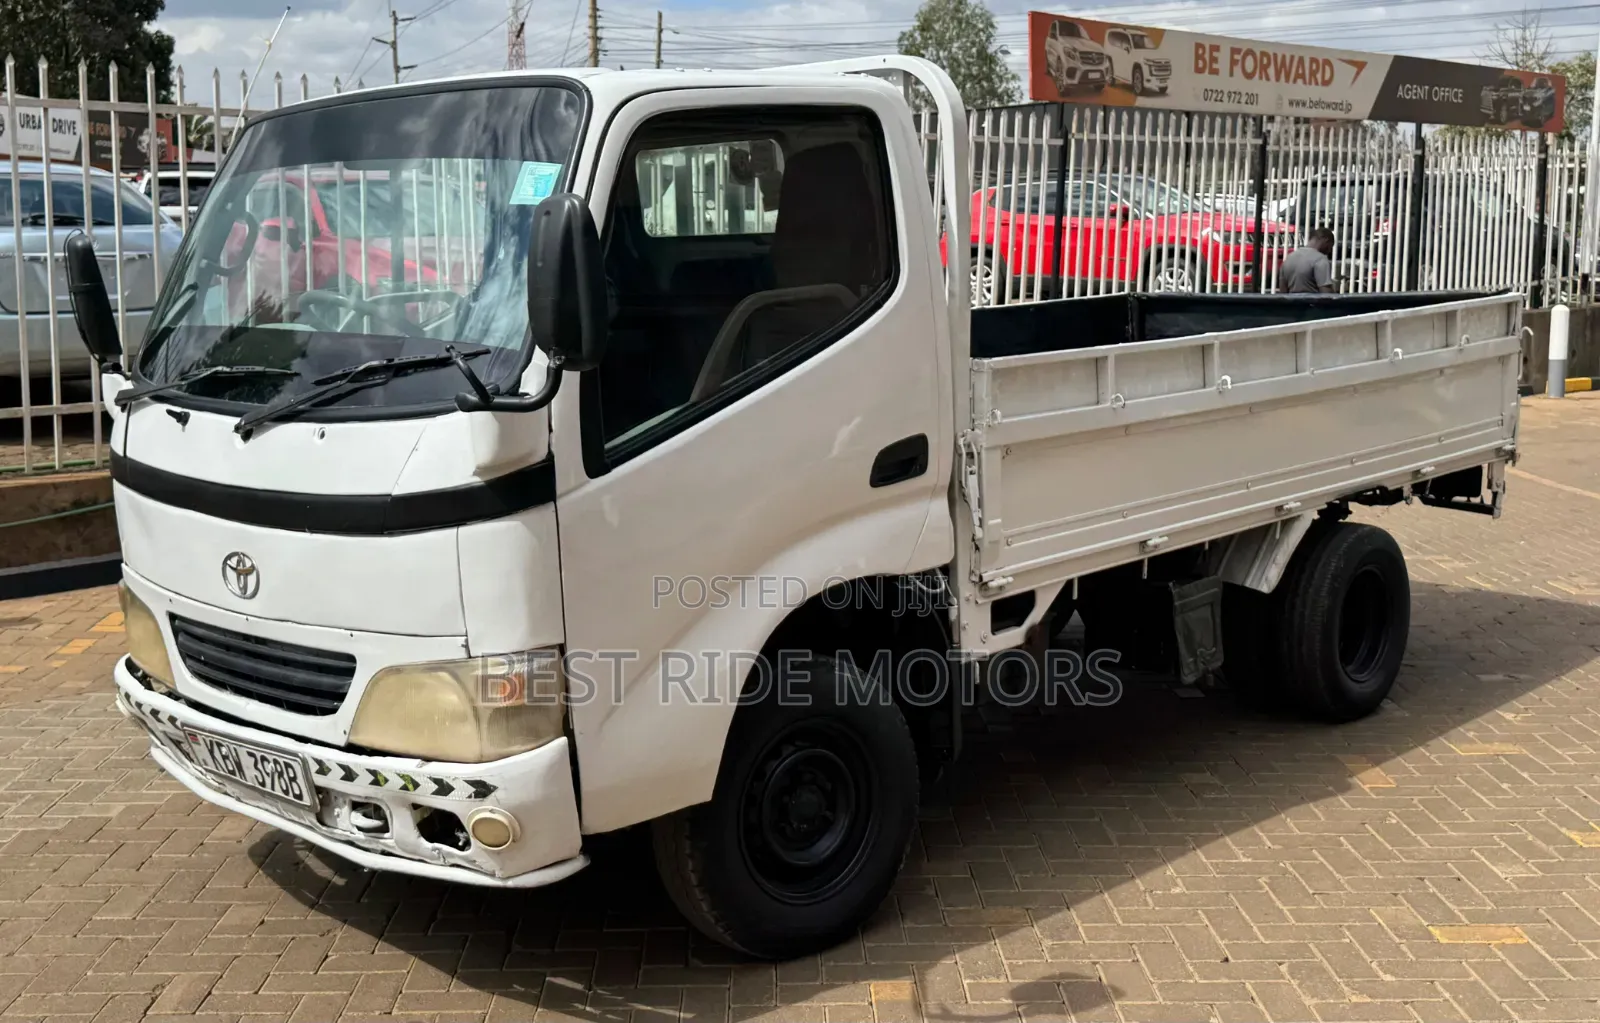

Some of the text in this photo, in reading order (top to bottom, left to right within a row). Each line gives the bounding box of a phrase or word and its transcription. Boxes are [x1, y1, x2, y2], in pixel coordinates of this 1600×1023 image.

[1194, 42, 1335, 87] BE FORWARD
[1203, 88, 1259, 106] 0722 972 201
[1397, 83, 1463, 103] AGENT OFFICE
[19, 112, 77, 136] URBA DRIVE
[203, 737, 304, 801] KBW 398B
